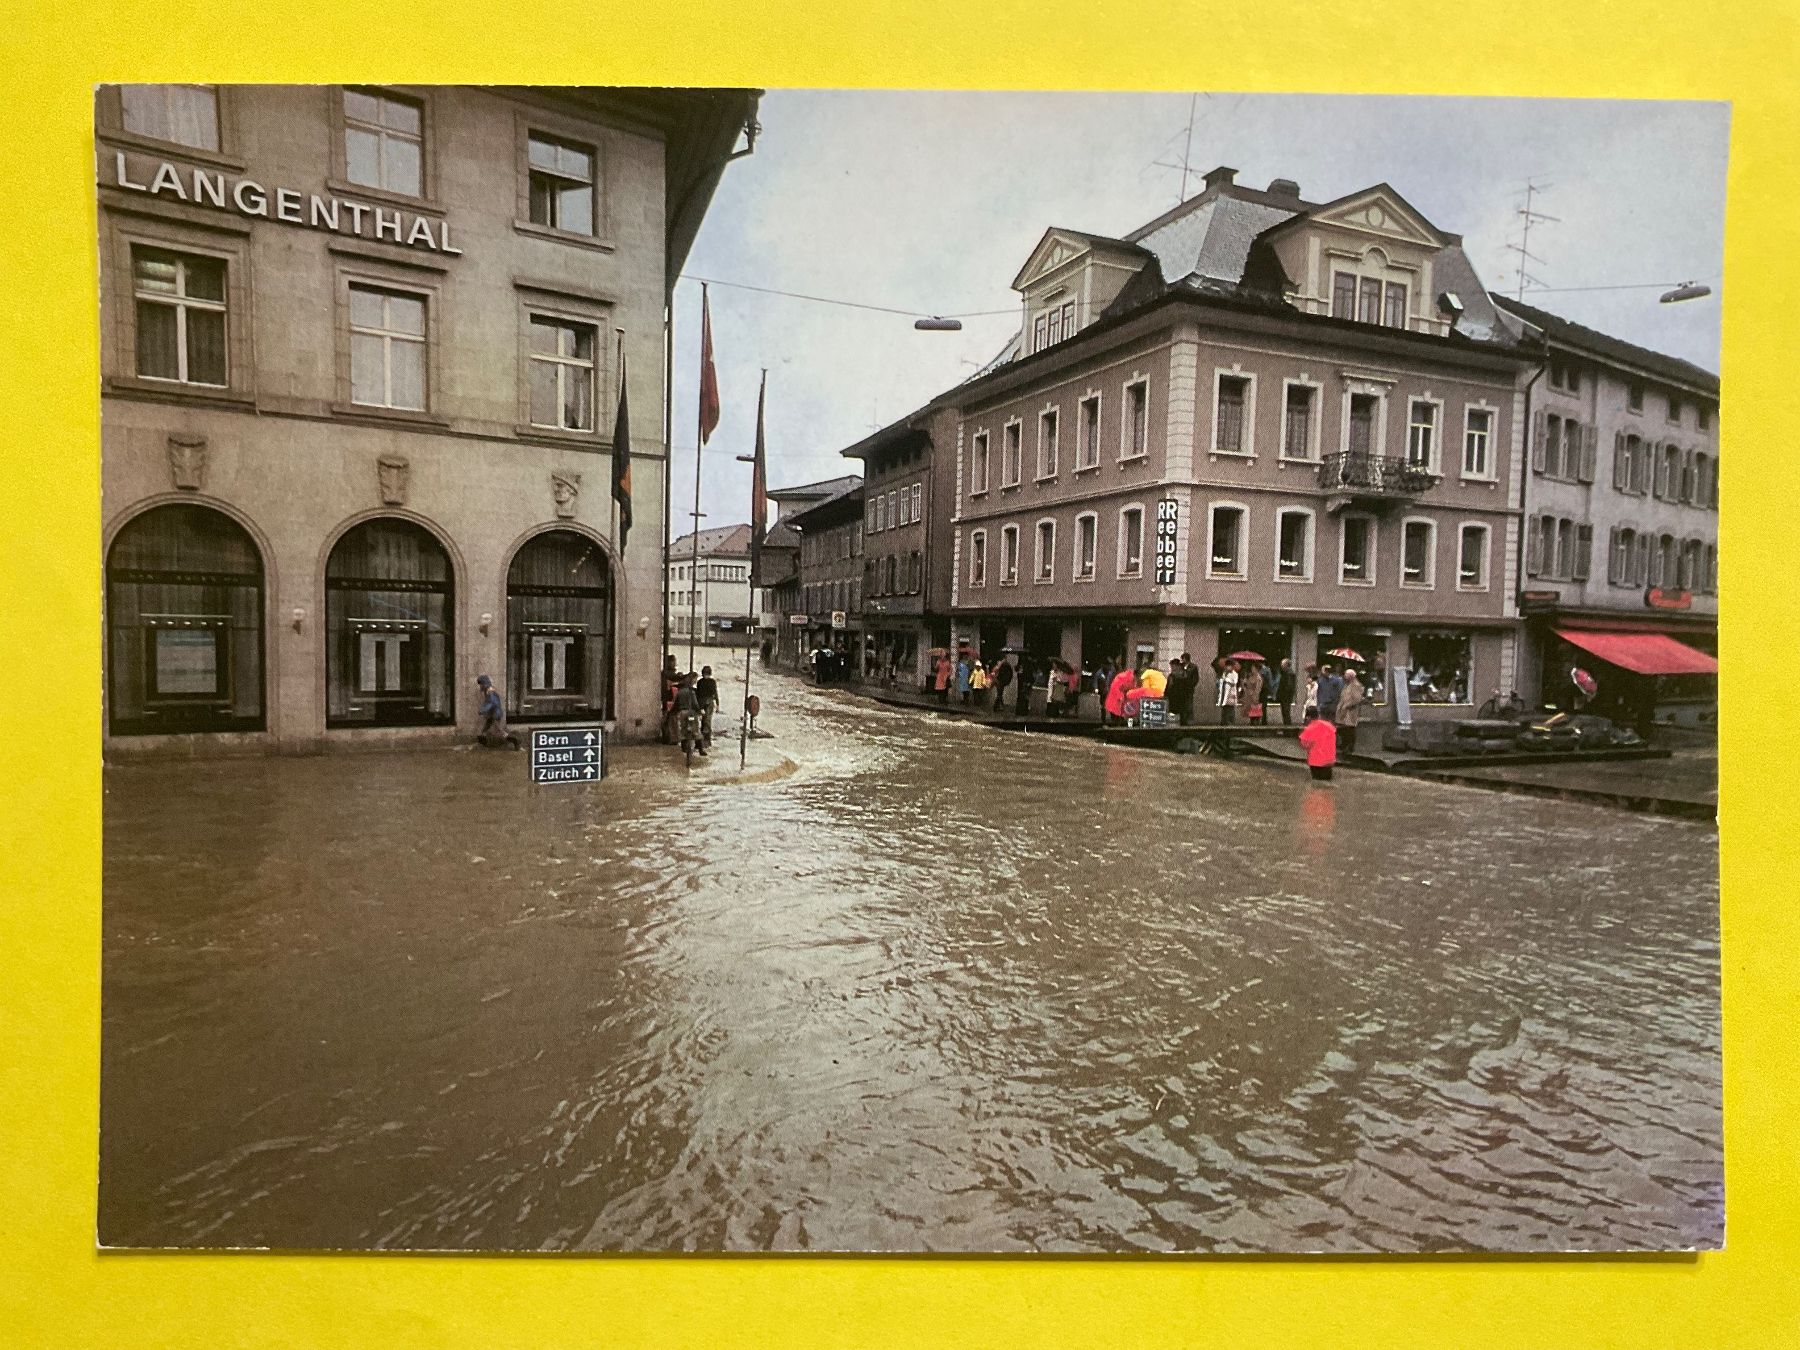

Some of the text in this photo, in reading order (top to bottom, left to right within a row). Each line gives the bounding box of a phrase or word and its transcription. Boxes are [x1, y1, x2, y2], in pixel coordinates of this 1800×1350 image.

[117, 152, 463, 254] LANGENTHAL
[1156, 501, 1166, 583] Reber
[1164, 501, 1177, 583] Reber
[539, 734, 569, 746] Bern
[539, 751, 573, 762] Basel
[539, 767, 579, 780] Zürich
